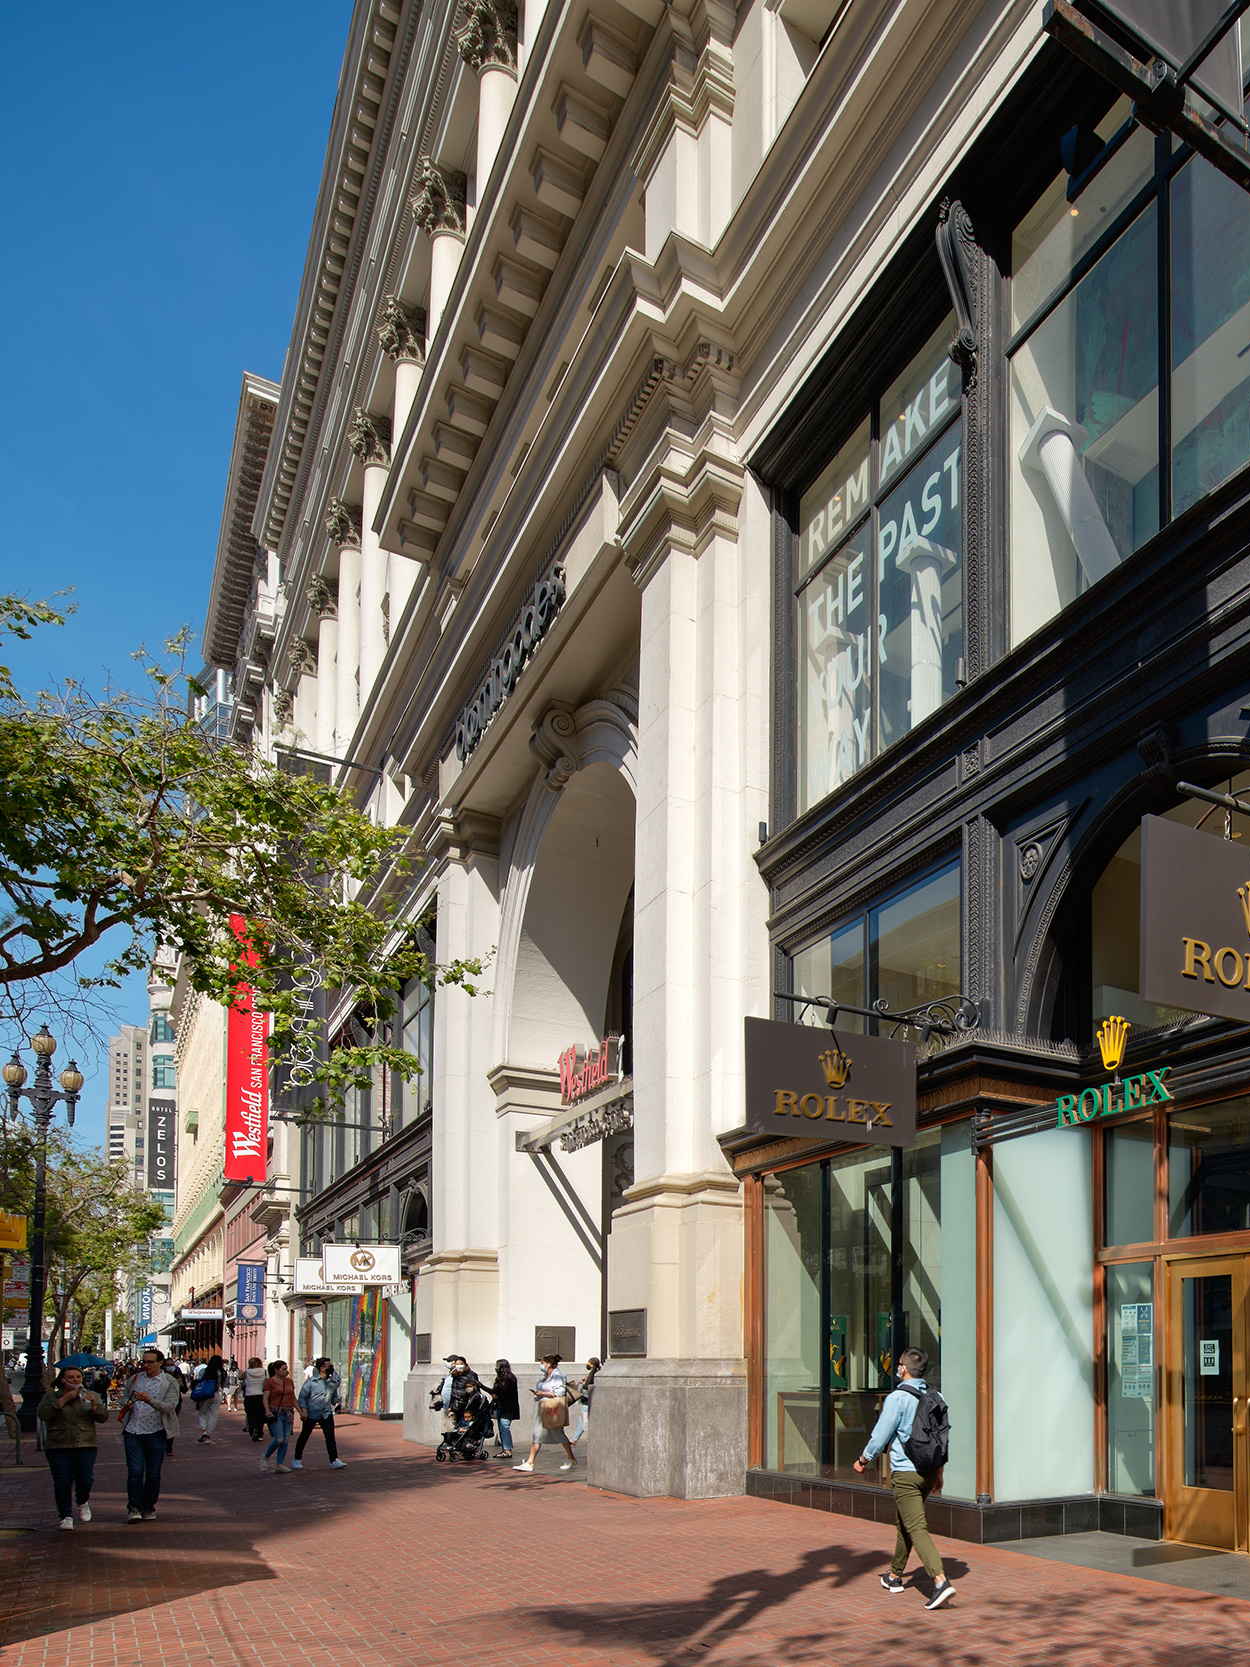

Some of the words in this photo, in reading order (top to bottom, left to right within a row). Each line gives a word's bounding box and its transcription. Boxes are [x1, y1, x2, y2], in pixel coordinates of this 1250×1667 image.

[808, 357, 949, 566] REMAKE
[808, 551, 864, 650] THE
[879, 446, 960, 584] PAST
[808, 613, 887, 725] YOUR
[808, 706, 871, 801] WAY
[251, 1011, 264, 1068] FRANCISCO
[557, 1036, 609, 1104] Westfield
[250, 1068, 262, 1089] SAN
[772, 1089, 895, 1127] ROLEX
[1055, 1066, 1175, 1128] ROLEX
[156, 1116, 166, 1180] ZELOS
[232, 1087, 262, 1158] Westfield
[141, 1287, 152, 1320] ROSS
